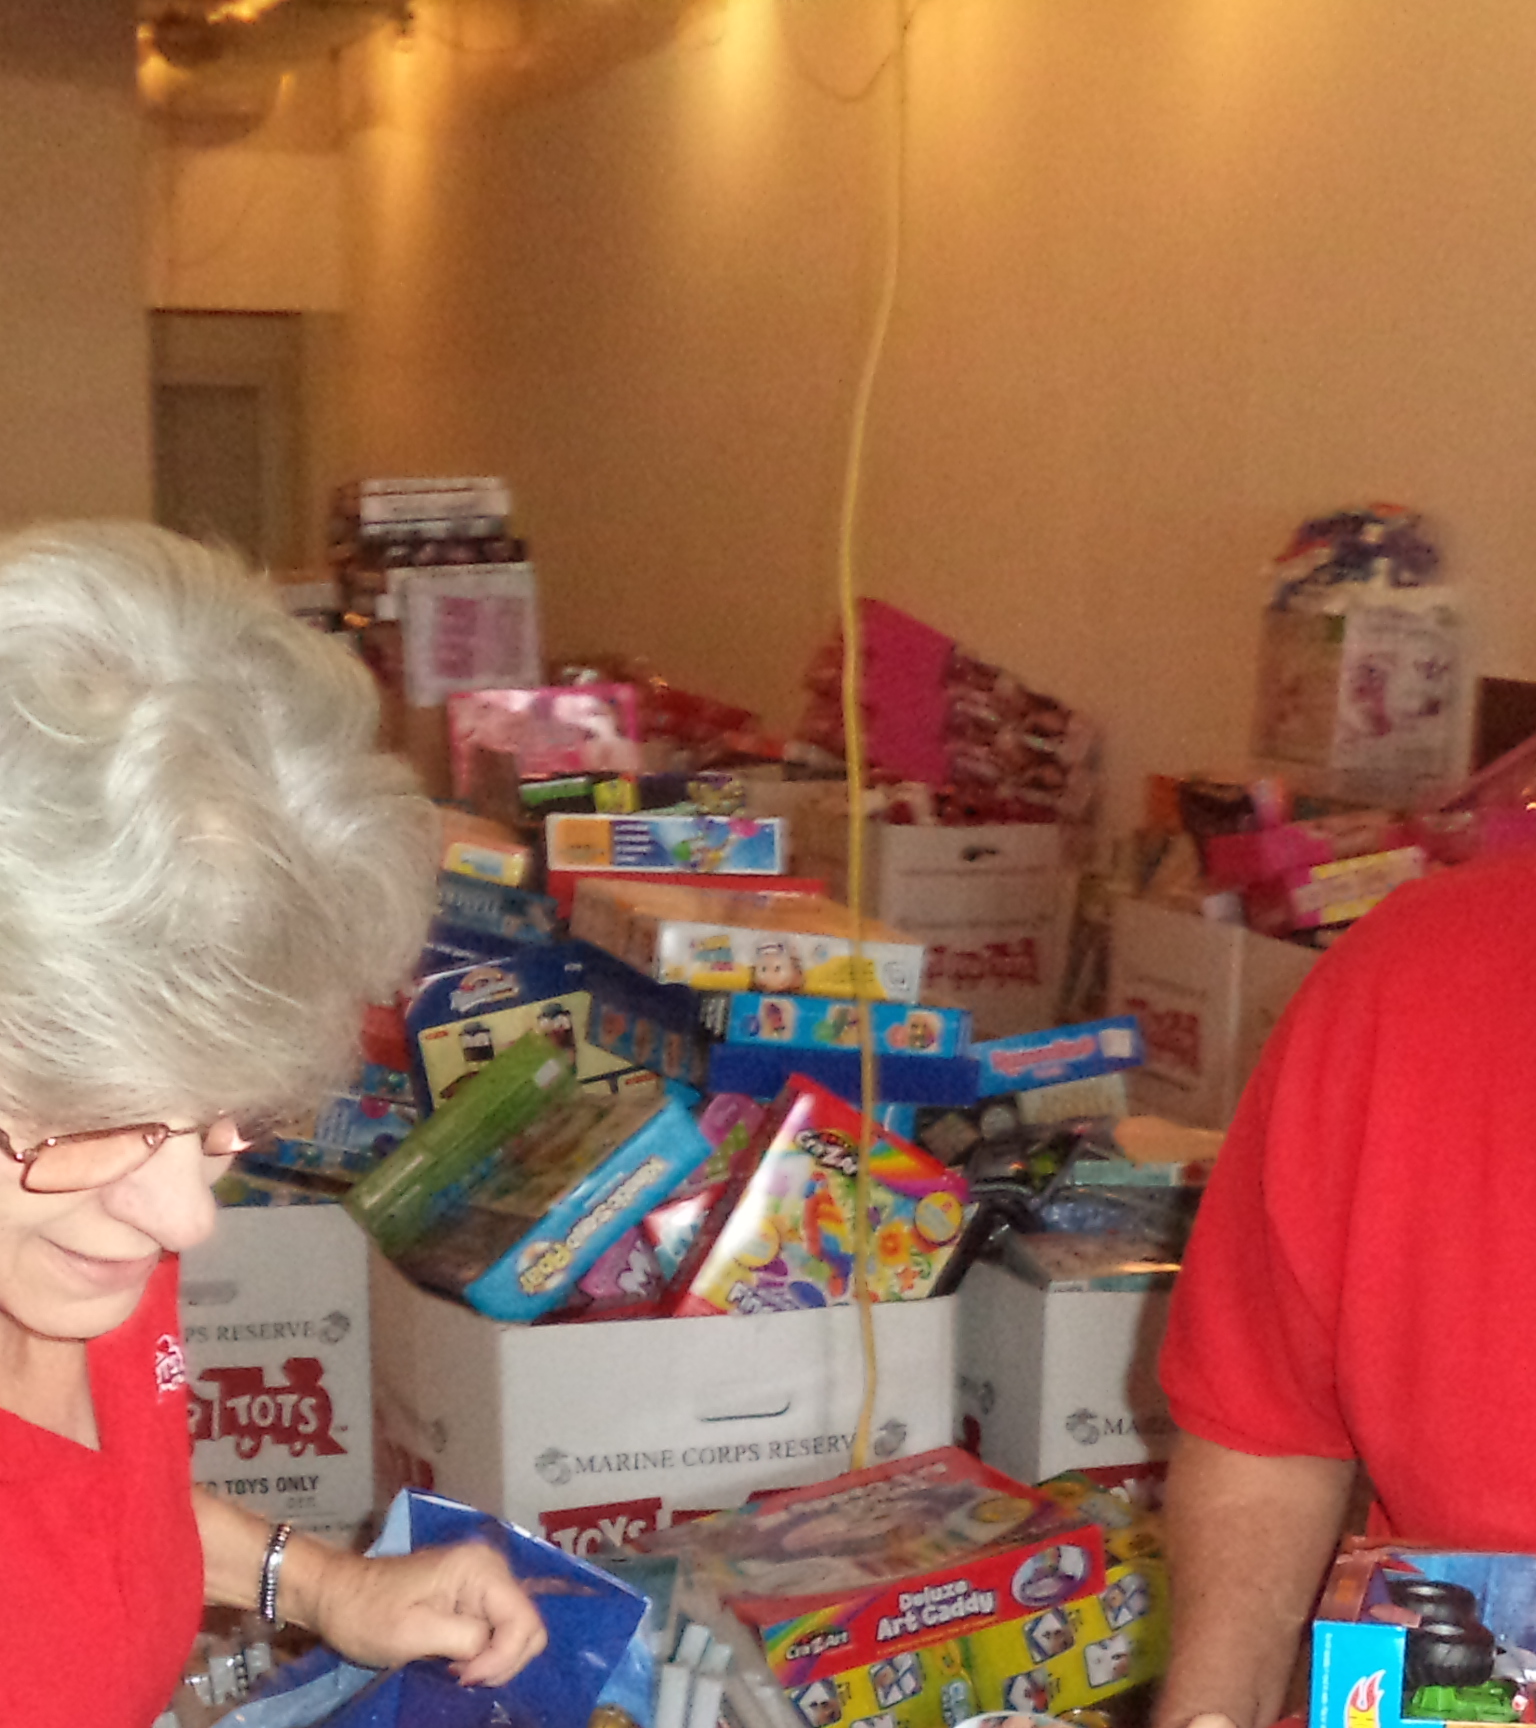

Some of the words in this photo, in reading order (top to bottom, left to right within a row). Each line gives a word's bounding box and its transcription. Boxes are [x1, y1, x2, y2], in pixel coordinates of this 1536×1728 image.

[226, 1394, 317, 1434] TOTS
[575, 1450, 673, 1474] MARINE
[682, 1444, 760, 1467] CORPS
[768, 1433, 857, 1460] RESERV
[225, 1477, 269, 1496] TOYS
[276, 1475, 319, 1493] ONLY
[875, 1612, 919, 1643] Art
[920, 1589, 997, 1628] Caddy
[898, 1579, 969, 1614] Deluxe
